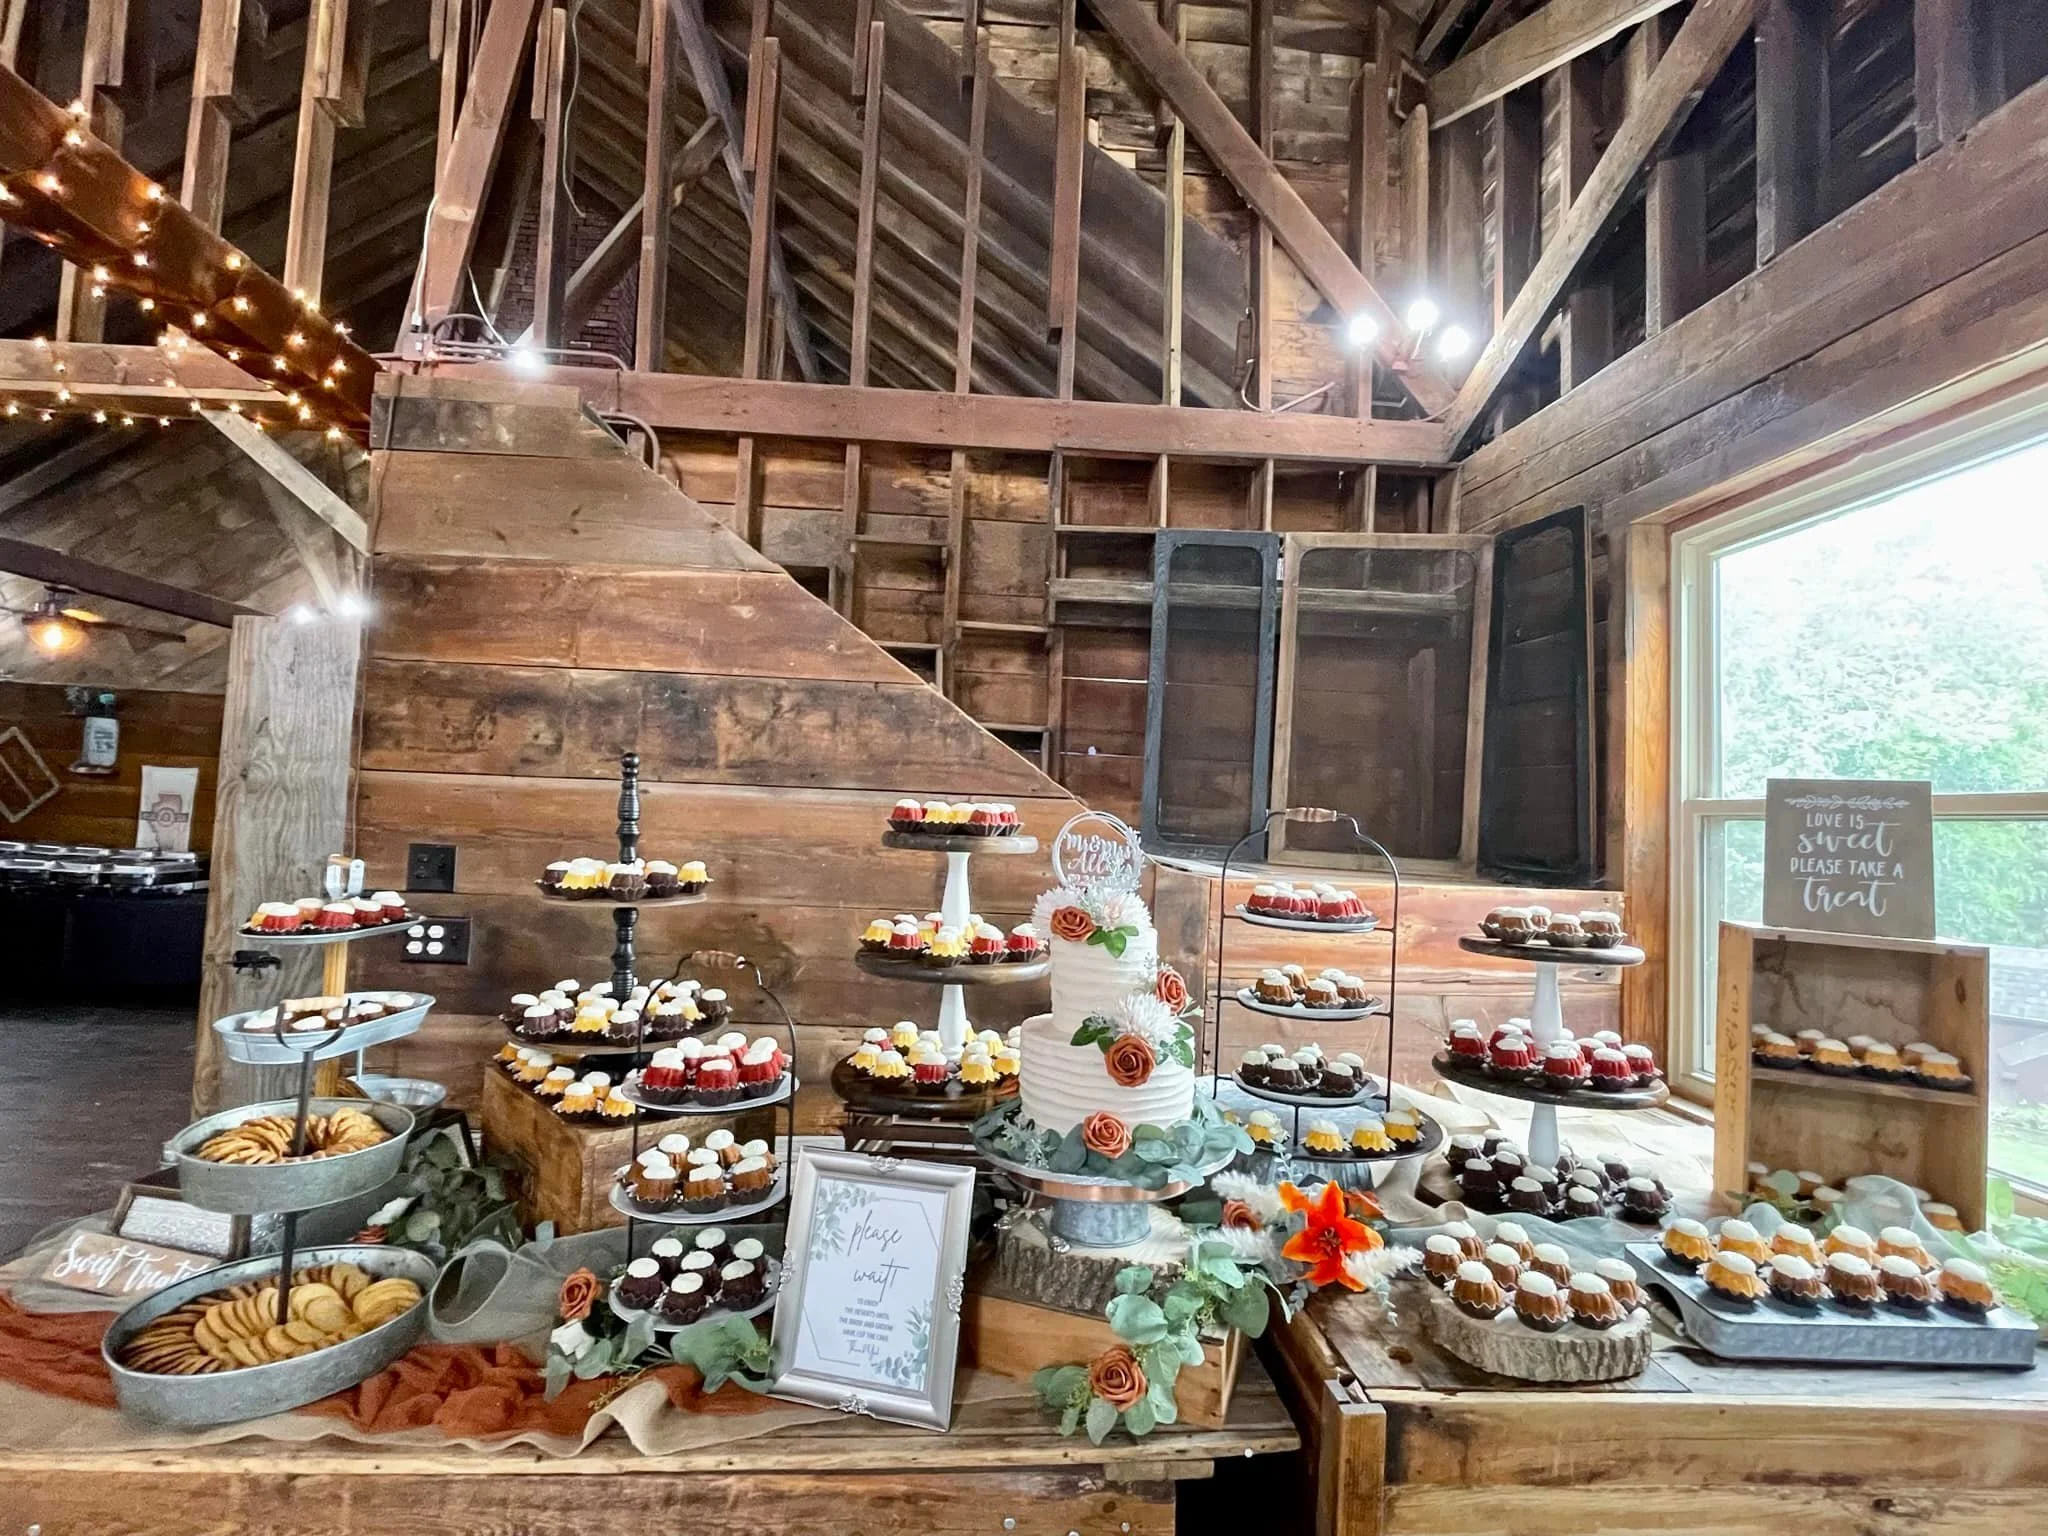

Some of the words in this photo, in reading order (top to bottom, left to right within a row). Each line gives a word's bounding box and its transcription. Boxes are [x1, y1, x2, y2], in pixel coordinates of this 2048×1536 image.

[1797, 821, 1903, 857] sweet
[1806, 813, 1844, 828] LOVE
[1850, 814, 1864, 830] IS
[1790, 857, 1844, 875] PLEASE
[1848, 859, 1886, 877] TAKE
[1892, 863, 1904, 880] A
[1793, 876, 1897, 917] treat
[847, 1209, 903, 1257] please
[52, 1234, 145, 1289] Sweet
